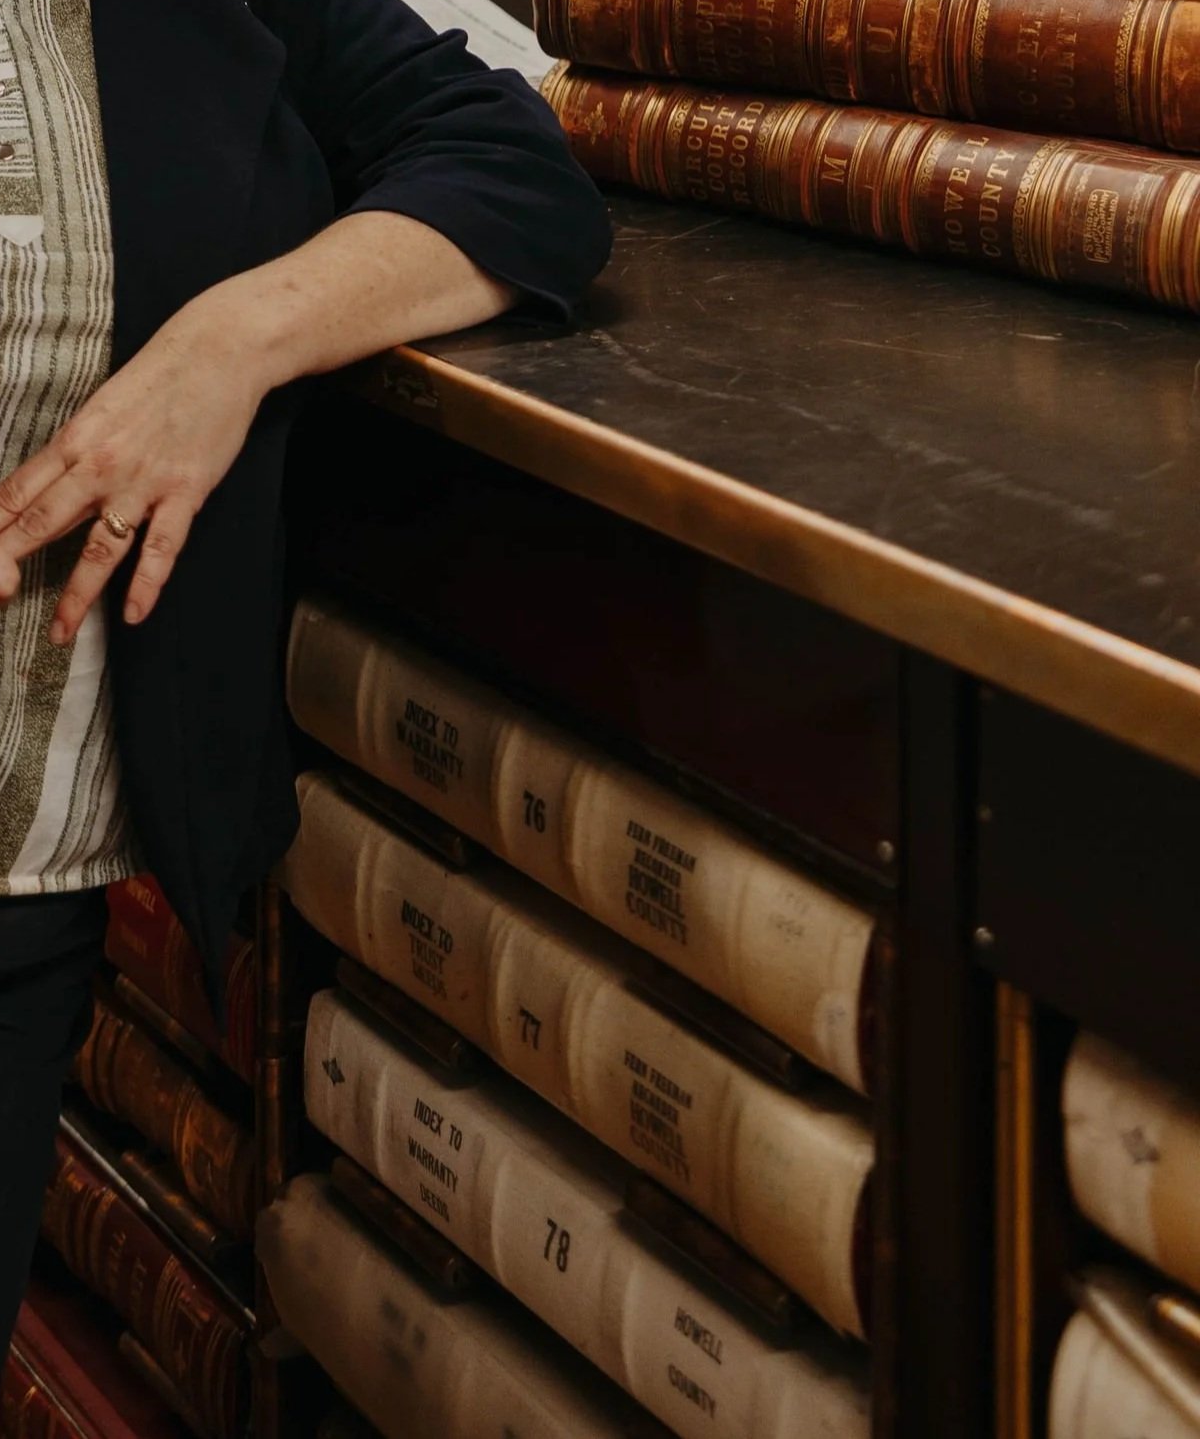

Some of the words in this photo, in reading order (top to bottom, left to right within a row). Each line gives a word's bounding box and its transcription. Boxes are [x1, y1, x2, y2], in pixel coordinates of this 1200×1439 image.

[686, 93, 724, 201] CIRCUI
[706, 107, 737, 194] COURT
[730, 101, 765, 204] RECORD
[821, 154, 848, 185] M
[944, 136, 990, 253] HOWELL
[978, 148, 1018, 258] COUNTY
[396, 720, 464, 780] WARRANTY
[404, 698, 440, 739] INDEX
[443, 720, 459, 749] TO
[522, 789, 546, 834] 76
[626, 890, 688, 946] COUNTY
[628, 864, 686, 919] HOWELL
[401, 899, 435, 942] INDEX
[438, 925, 454, 954] TO
[408, 932, 445, 975] TRUST
[518, 1004, 542, 1051] 77
[414, 1097, 445, 1138] INDEX
[448, 1124, 463, 1152] TO
[630, 1097, 687, 1159] HOWELL
[408, 1134, 459, 1194] WARRANTY
[630, 1123, 691, 1186] COUNTY
[419, 1182, 450, 1223] DEEDS
[543, 1217, 570, 1273] 78
[674, 1305, 722, 1365] HOWELL
[668, 1363, 716, 1421] COUNTY
